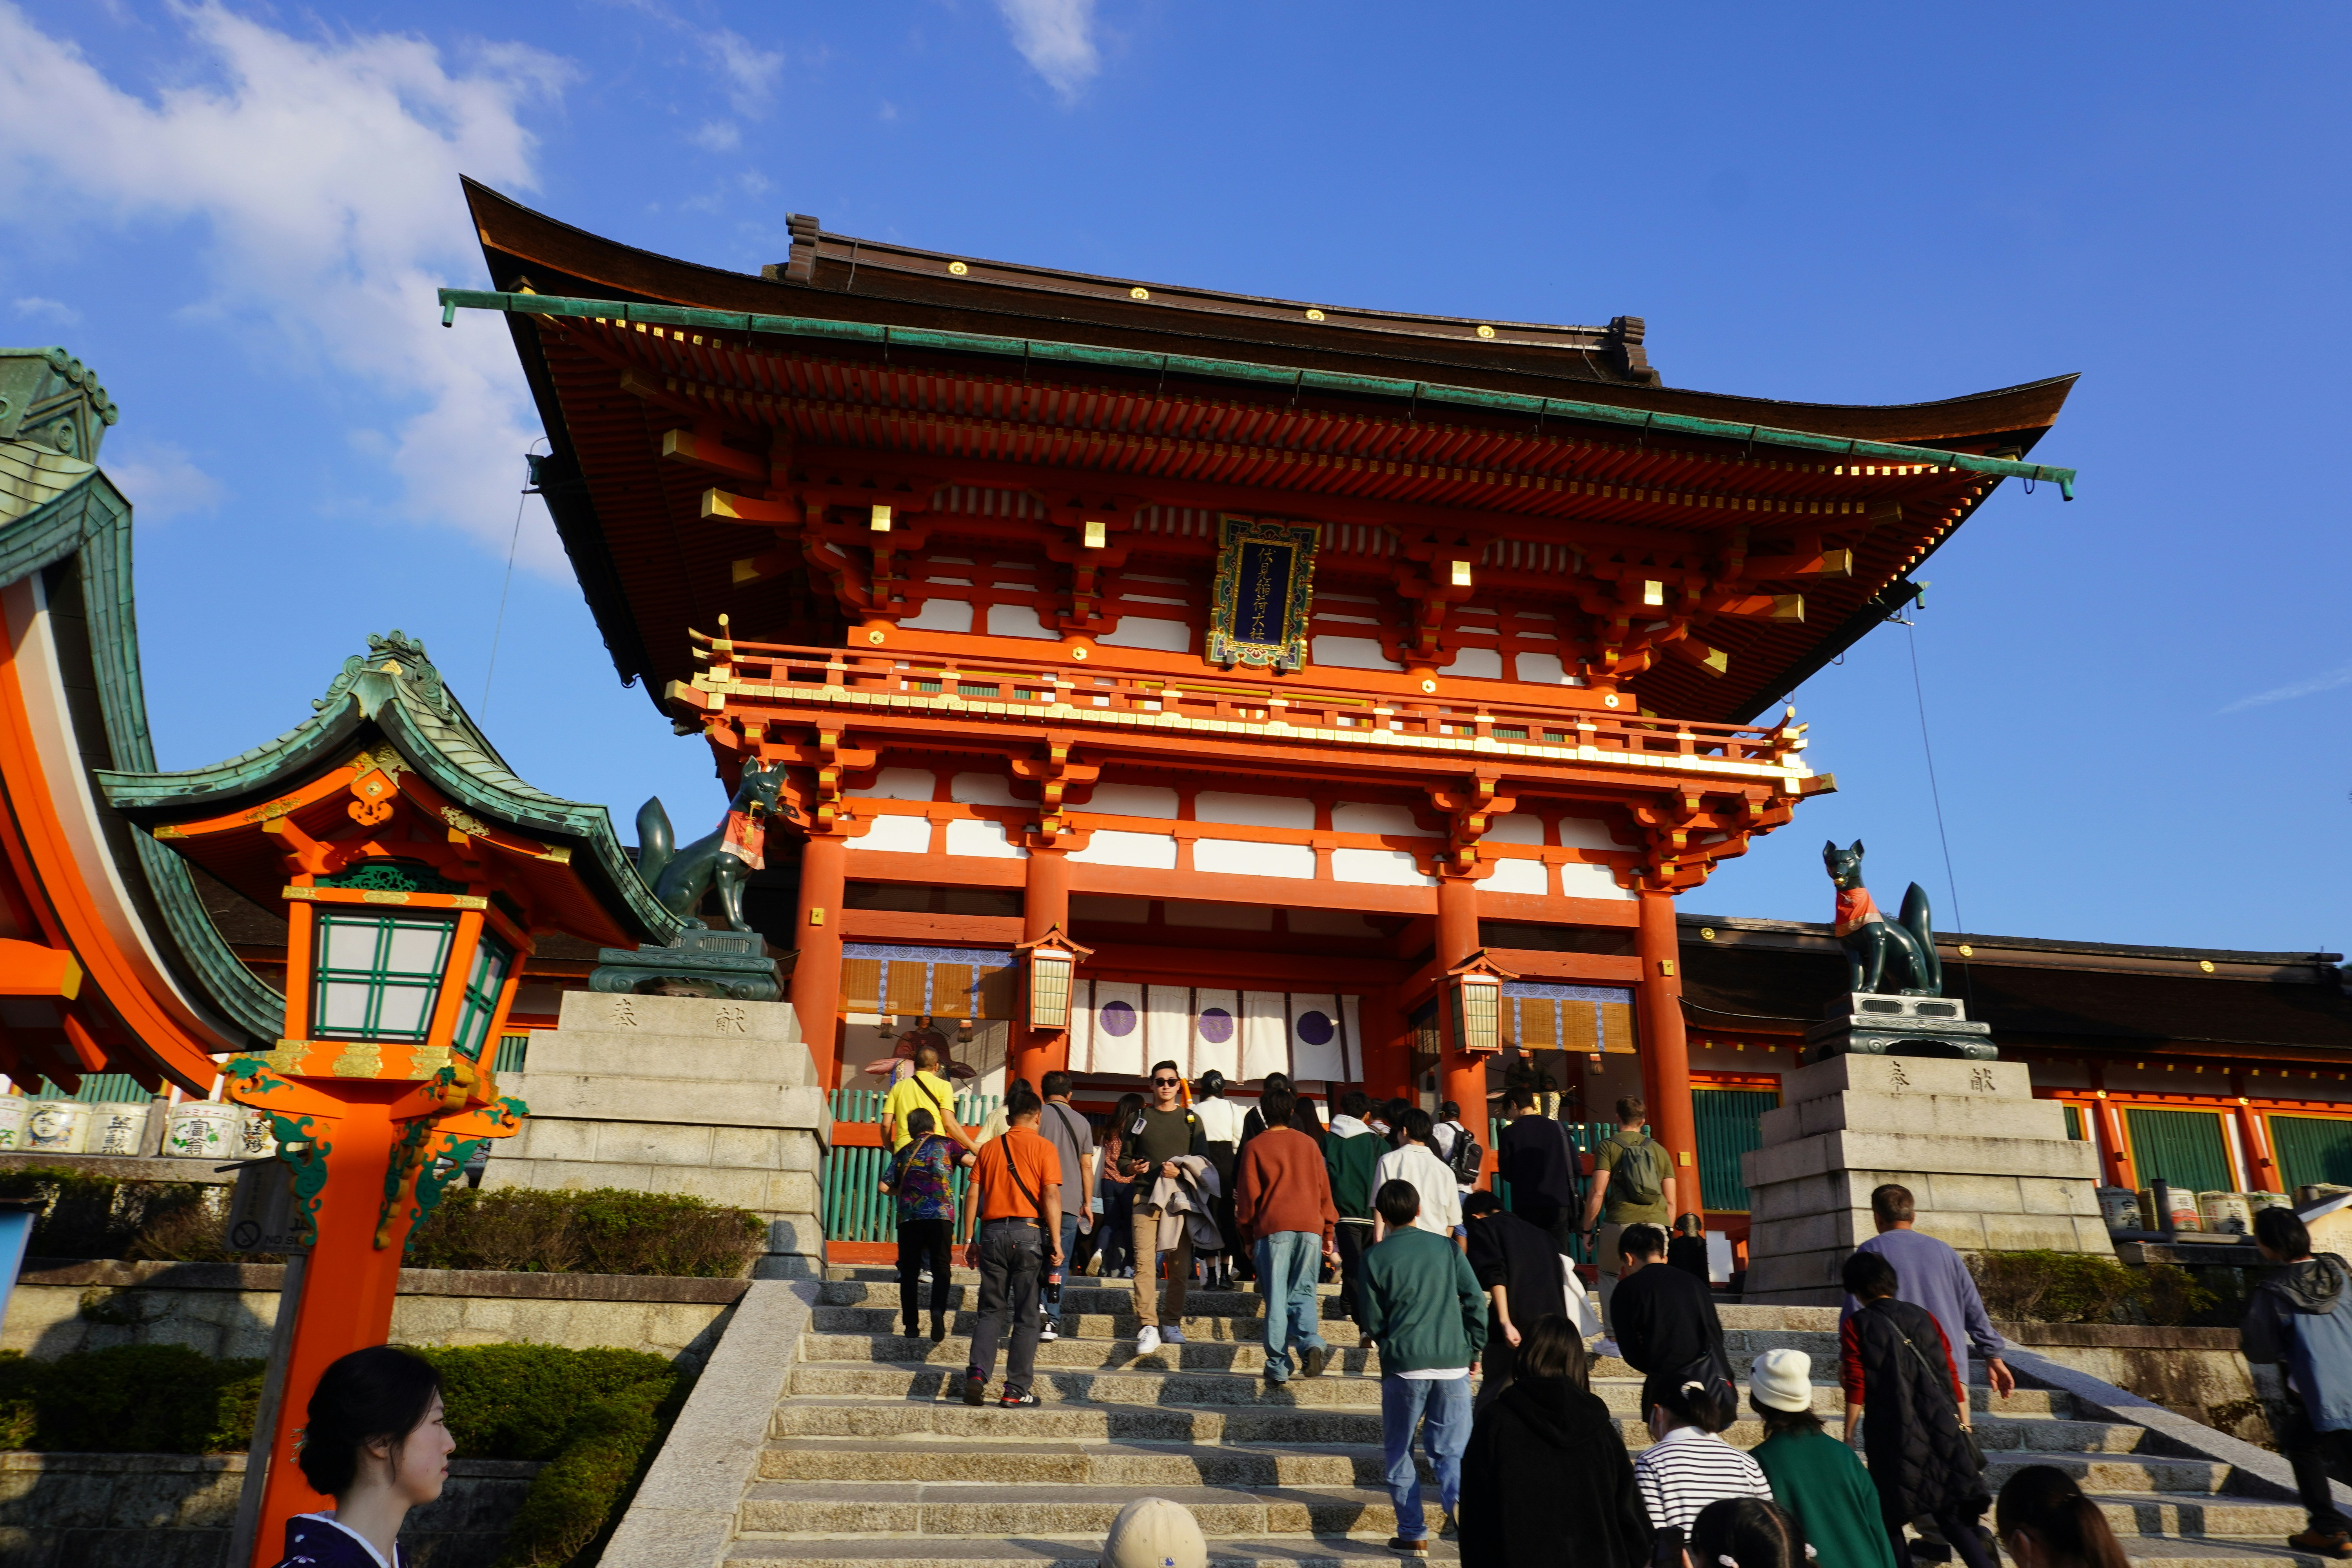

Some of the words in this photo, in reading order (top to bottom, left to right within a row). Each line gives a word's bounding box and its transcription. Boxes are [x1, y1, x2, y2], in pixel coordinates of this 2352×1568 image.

[1249, 548, 1276, 641] 伏見稲荷大社
[185, 1119, 211, 1154] 富翁
